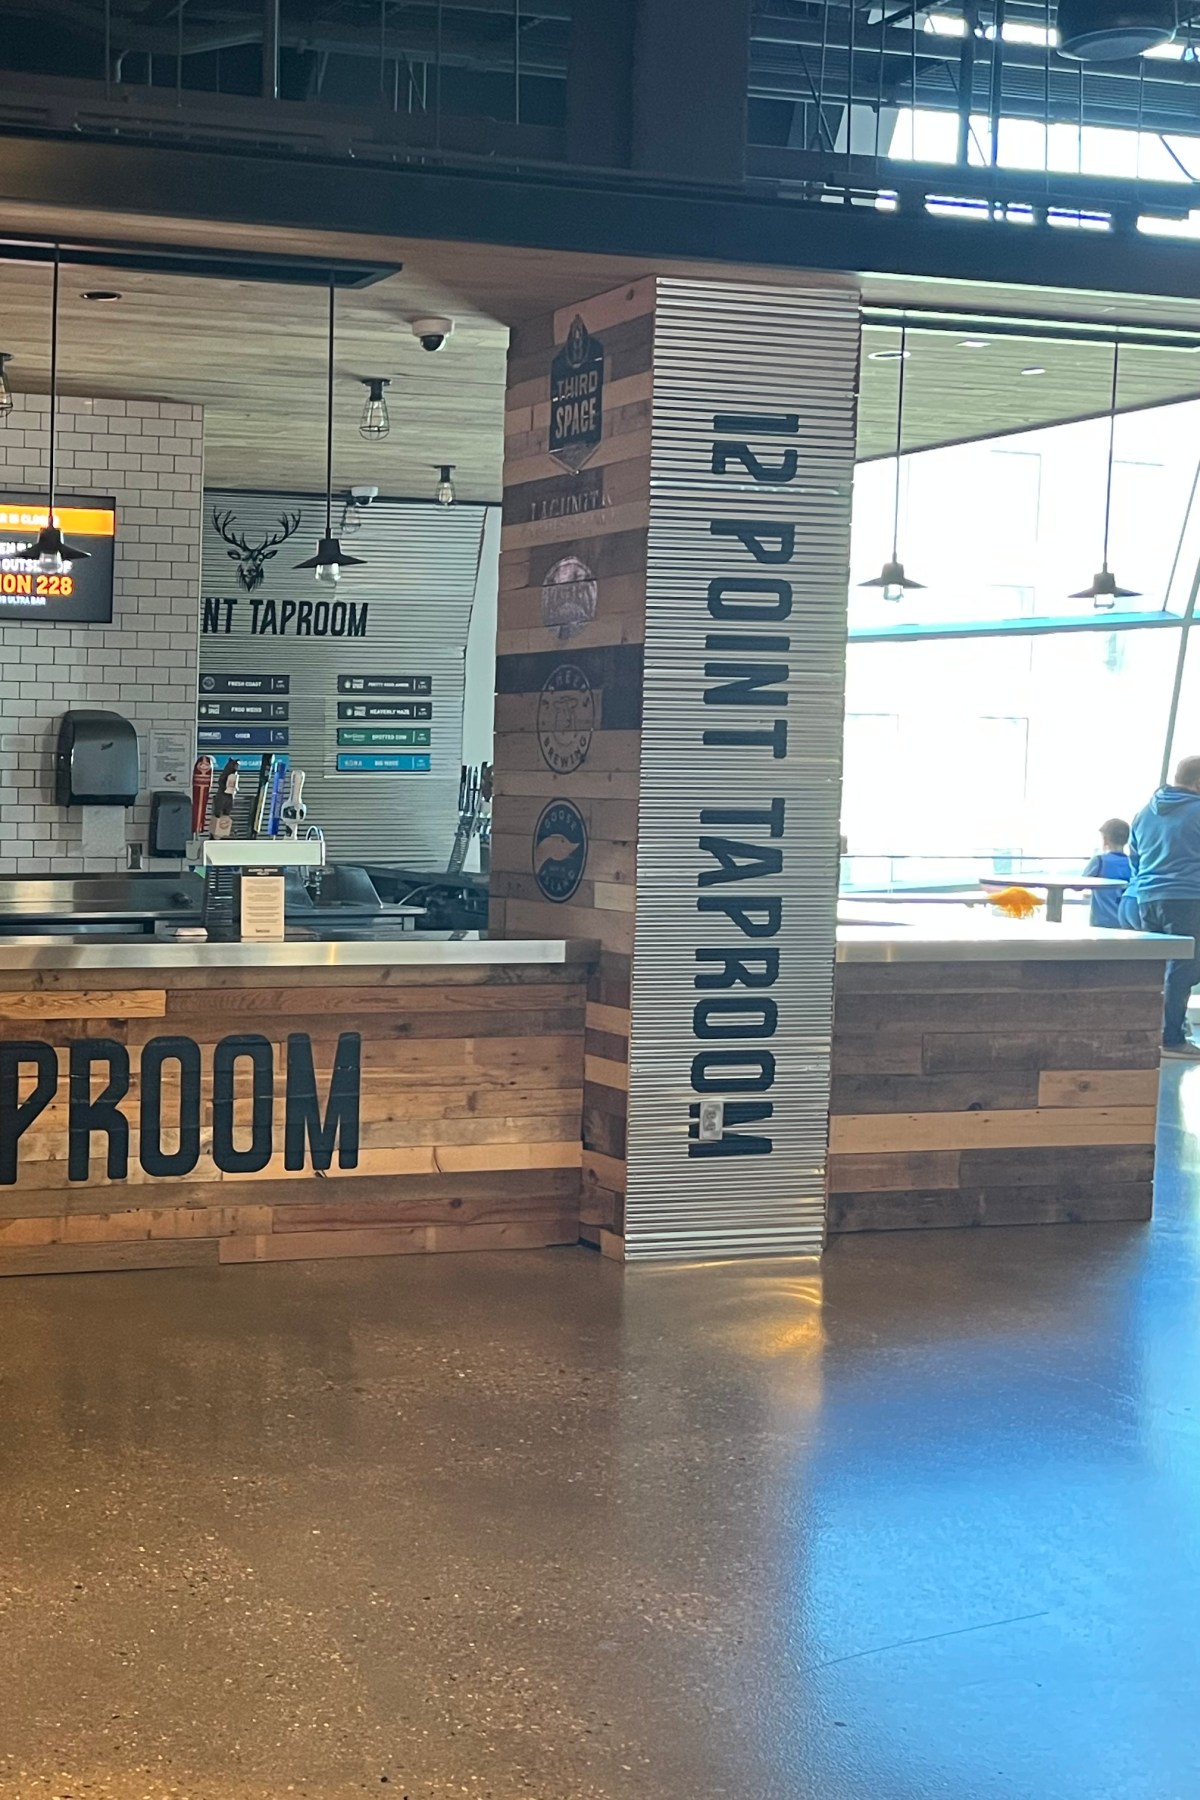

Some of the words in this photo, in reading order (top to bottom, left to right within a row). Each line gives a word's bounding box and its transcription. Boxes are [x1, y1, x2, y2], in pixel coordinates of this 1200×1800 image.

[557, 370, 598, 400] THIRD
[556, 398, 597, 438] SPACE
[711, 414, 800, 483] 12
[36, 575, 74, 596] 228
[250, 600, 369, 637] TAPROOM
[702, 520, 796, 760] POINT
[687, 797, 786, 1159] TAPROOM
